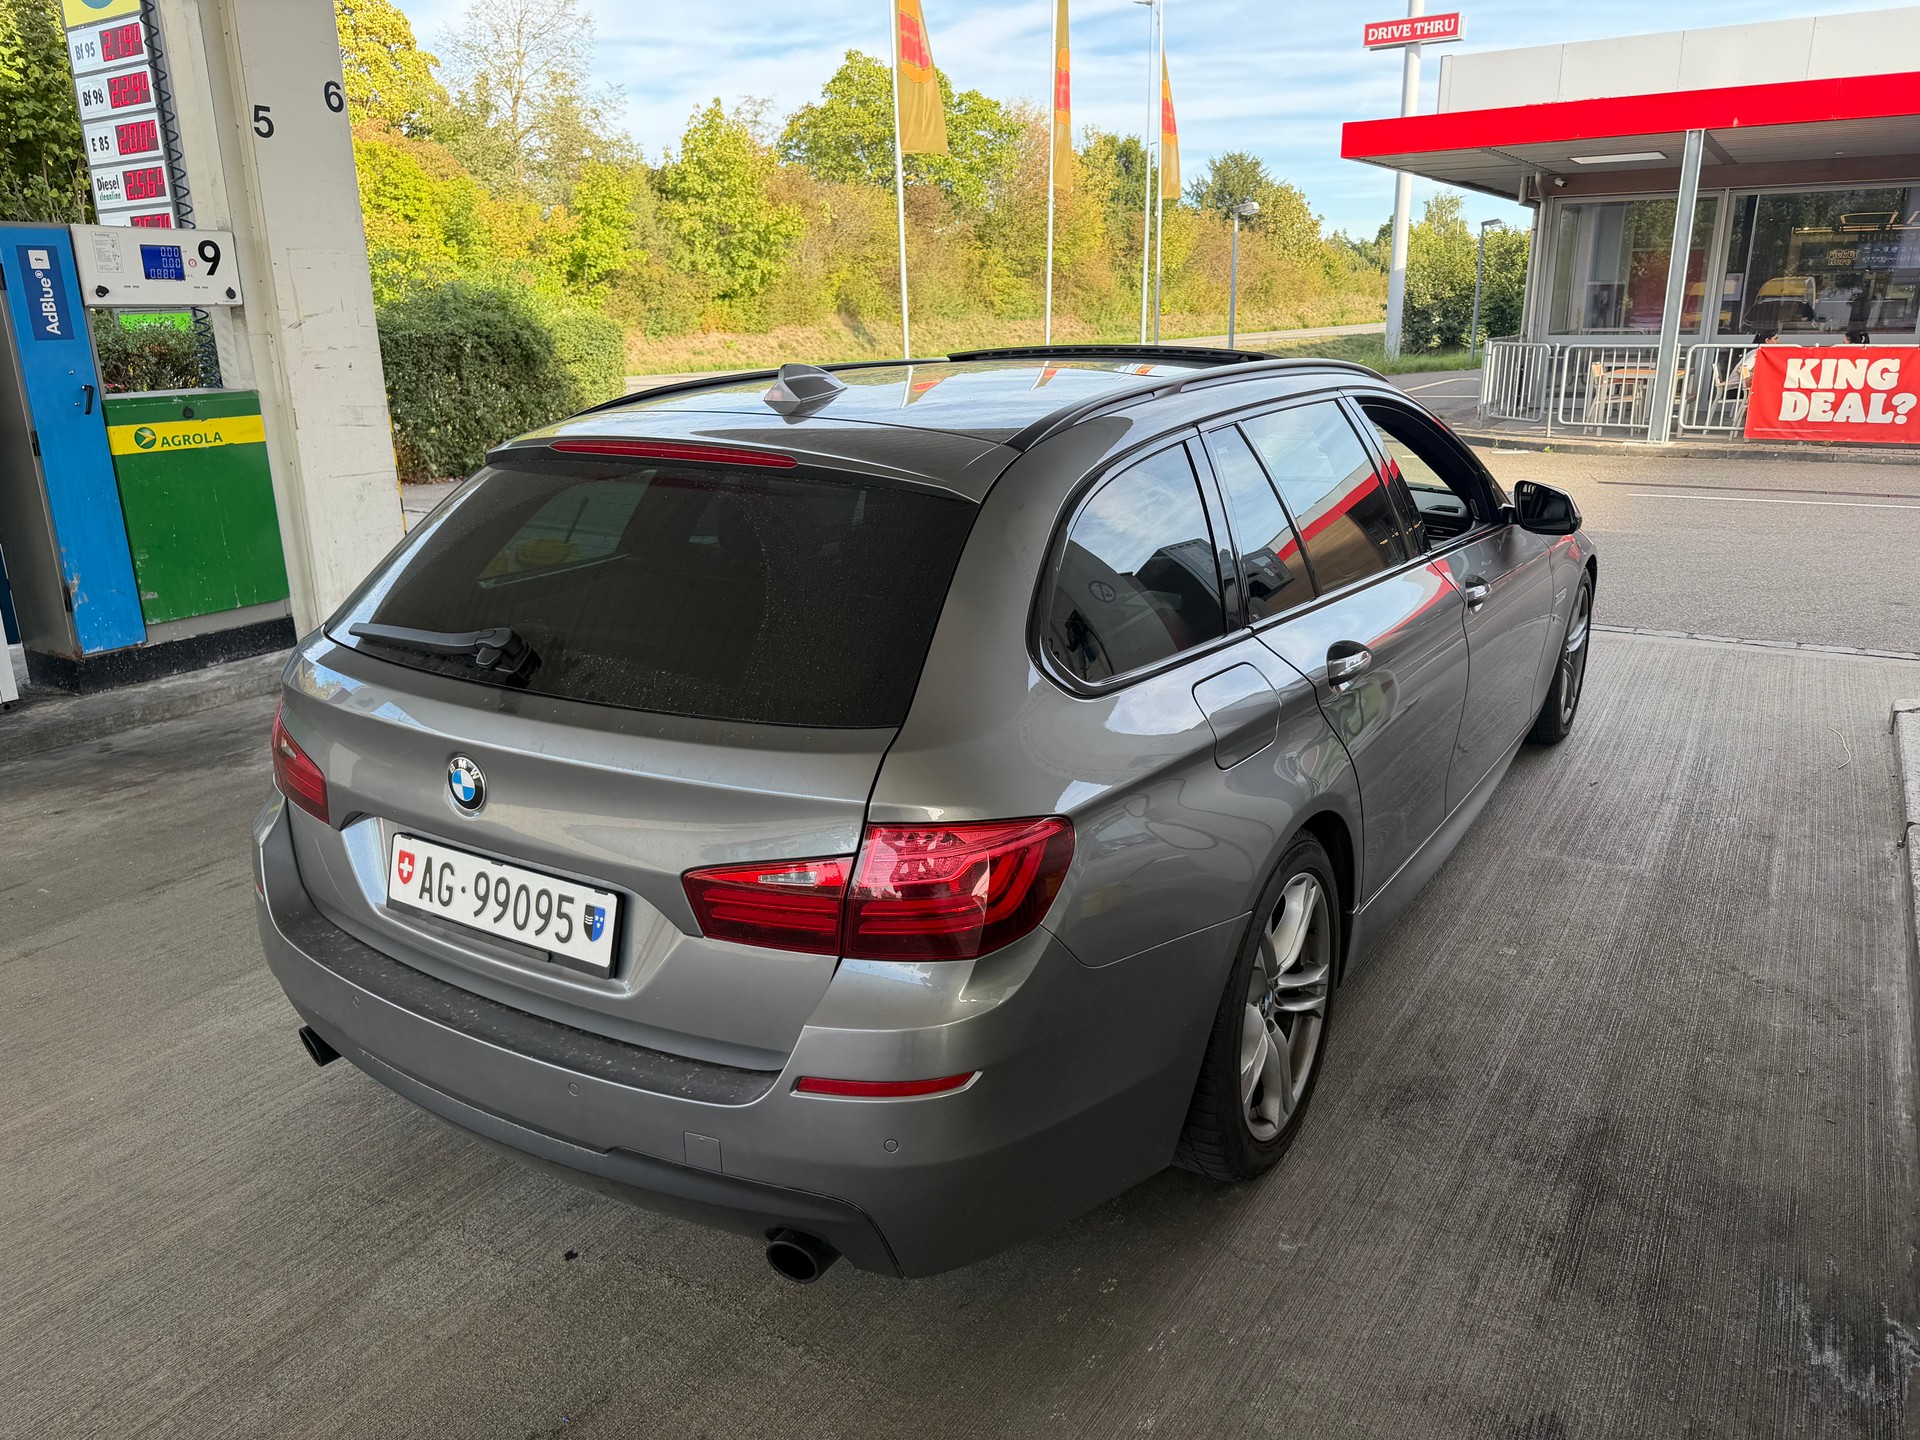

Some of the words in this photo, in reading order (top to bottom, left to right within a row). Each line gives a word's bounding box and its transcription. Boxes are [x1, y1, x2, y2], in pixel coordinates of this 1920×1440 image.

[1368, 23, 1412, 41] DRIVE
[1414, 18, 1455, 35] THRU
[74, 43, 84, 60] Bf
[84, 41, 96, 58] 95
[82, 89, 92, 107] Bf
[92, 88, 104, 104] 98
[324, 80, 344, 113] 6
[254, 104, 274, 138] 5
[91, 137, 97, 153] E
[98, 135, 110, 151] 85
[96, 174, 120, 191] Diesel
[160, 246, 180, 257] 0.00
[198, 240, 221, 276] 9
[162, 257, 181, 268] 0.00
[1783, 358, 1901, 391] KING
[1778, 391, 1918, 425] DEAL?
[161, 431, 223, 448] AGROLA
[449, 759, 481, 780] BMW
